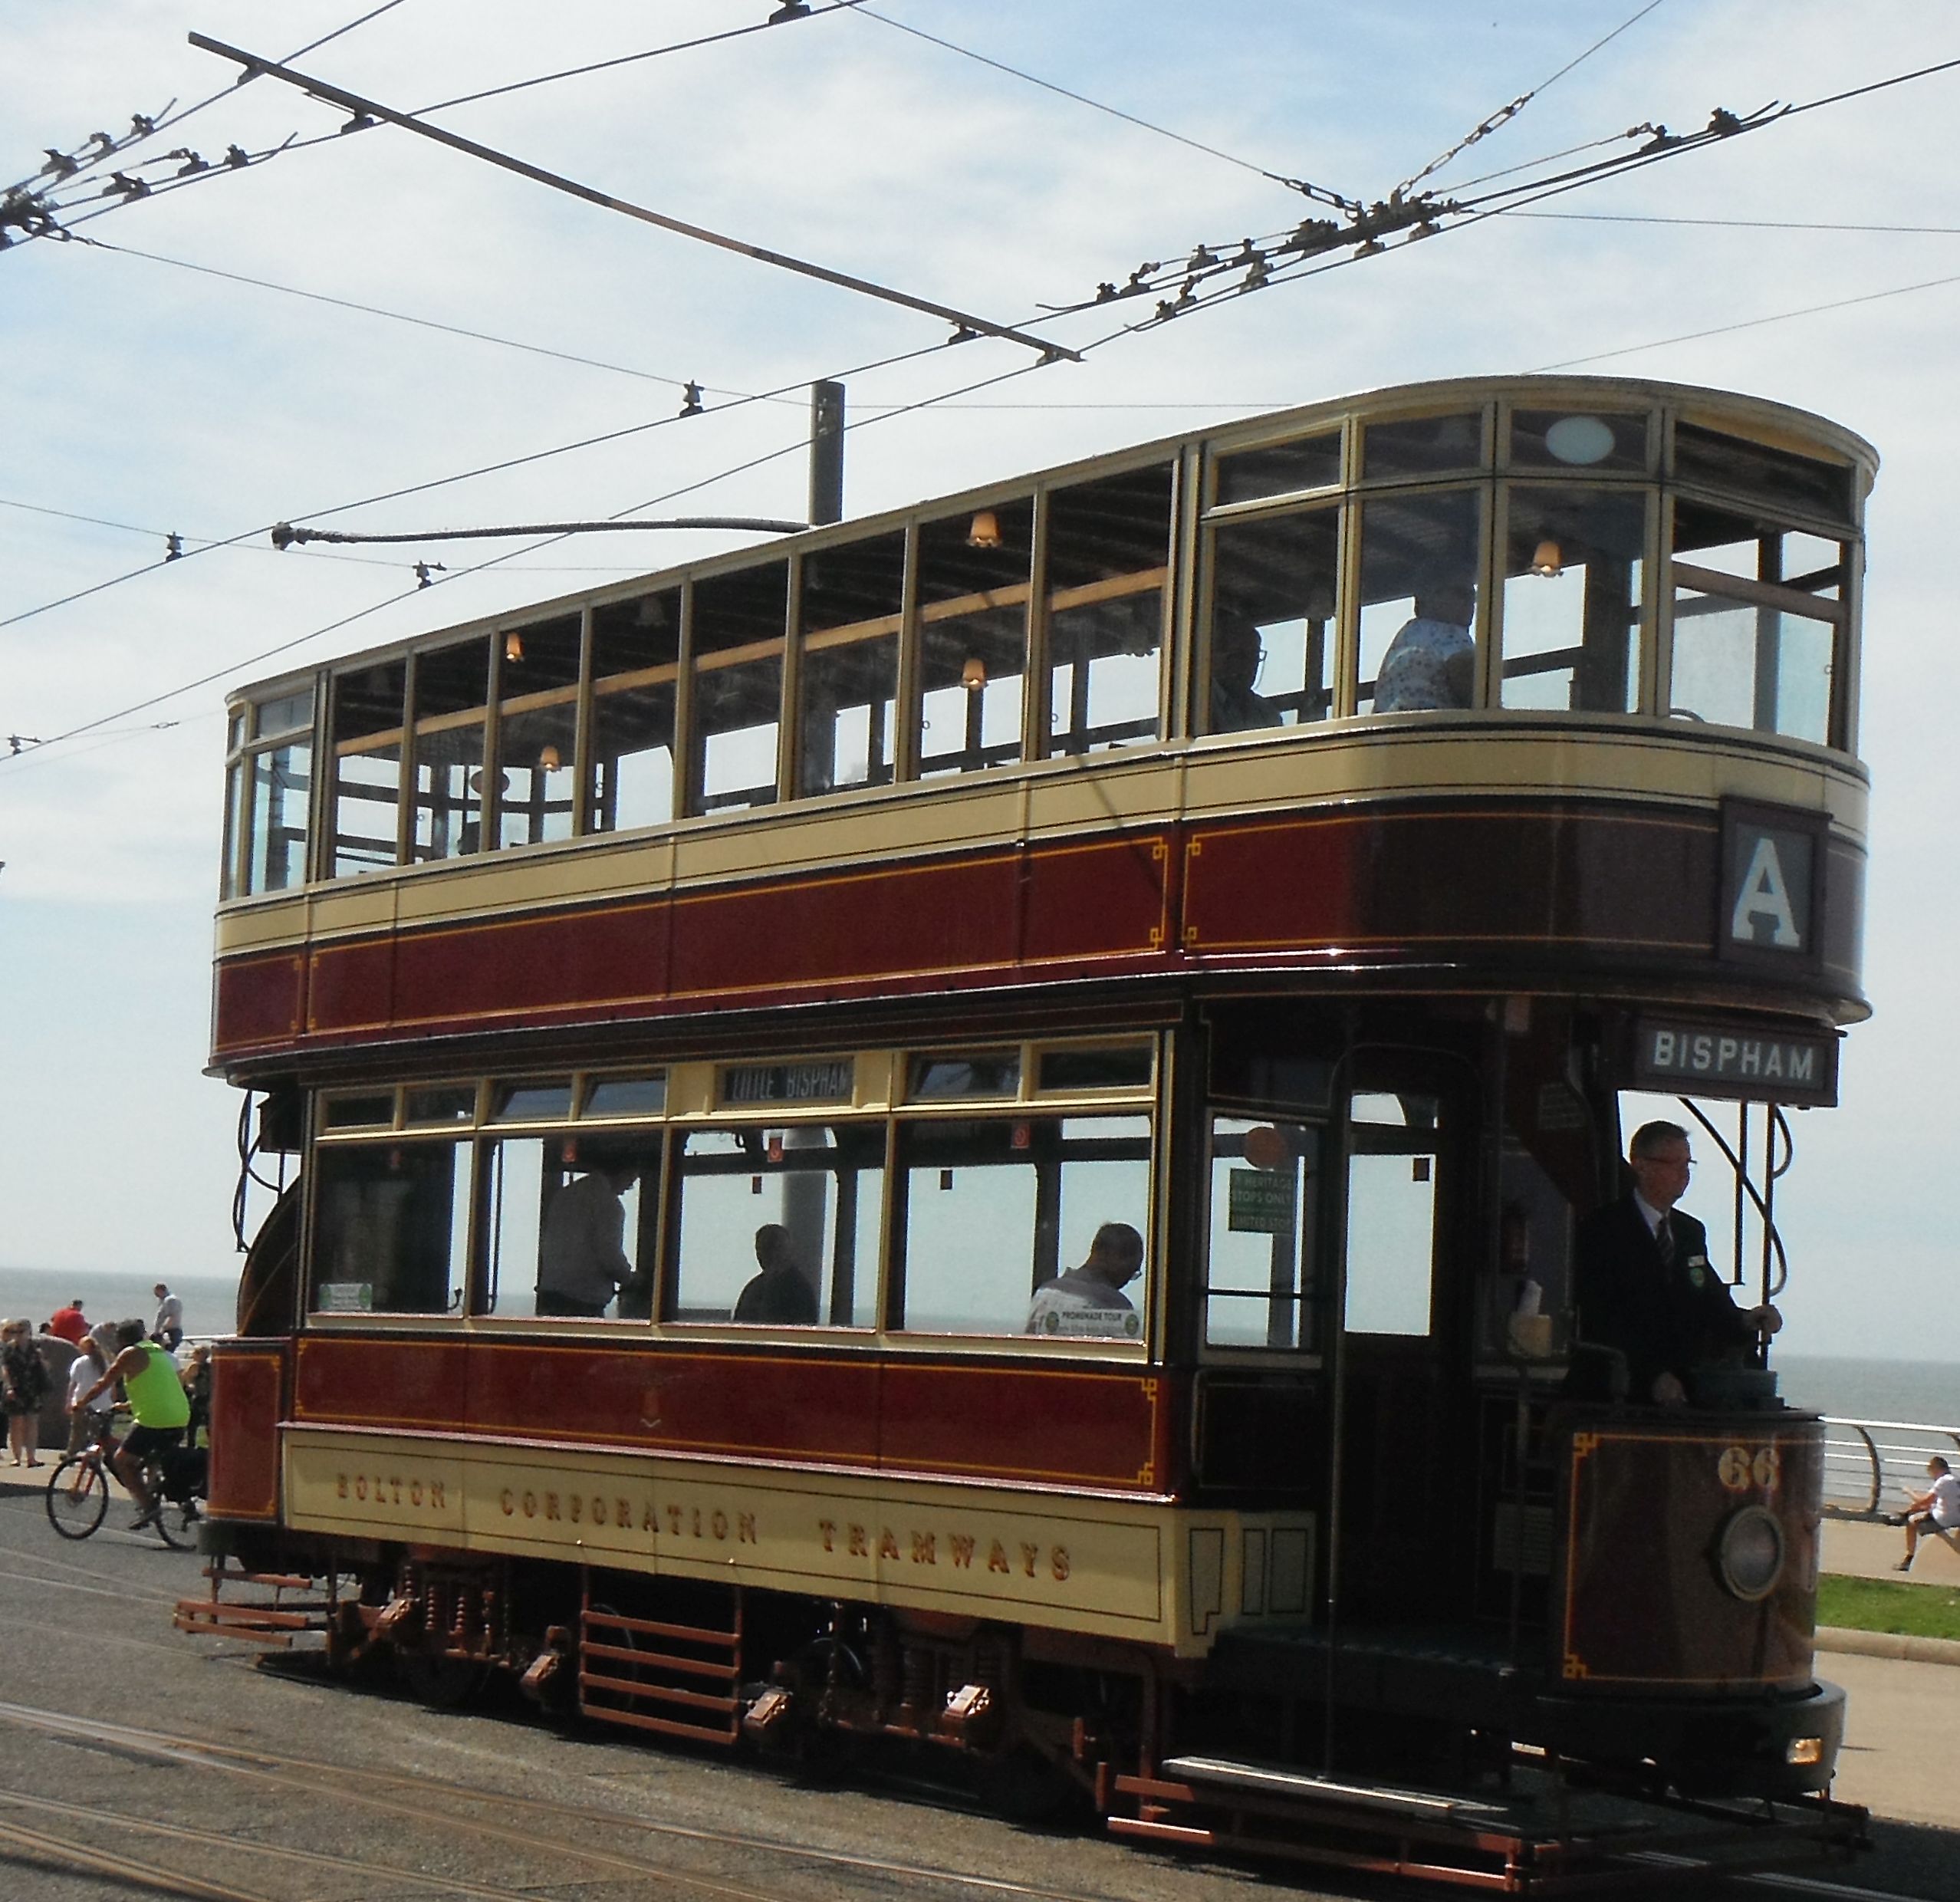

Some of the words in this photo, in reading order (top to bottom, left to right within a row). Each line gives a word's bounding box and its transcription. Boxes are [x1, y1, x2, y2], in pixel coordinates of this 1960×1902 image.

[1731, 837, 1801, 947] A
[1653, 1031, 1814, 1080] BISPHAM
[1061, 1311, 1102, 1320] PROMENADE
[1104, 1312, 1122, 1321] TOUR
[1718, 1446, 1780, 1491] 66
[337, 1473, 446, 1509] BOLTON
[501, 1488, 759, 1545] CORPORATION
[819, 1519, 1071, 1581] TRAMWAYS
